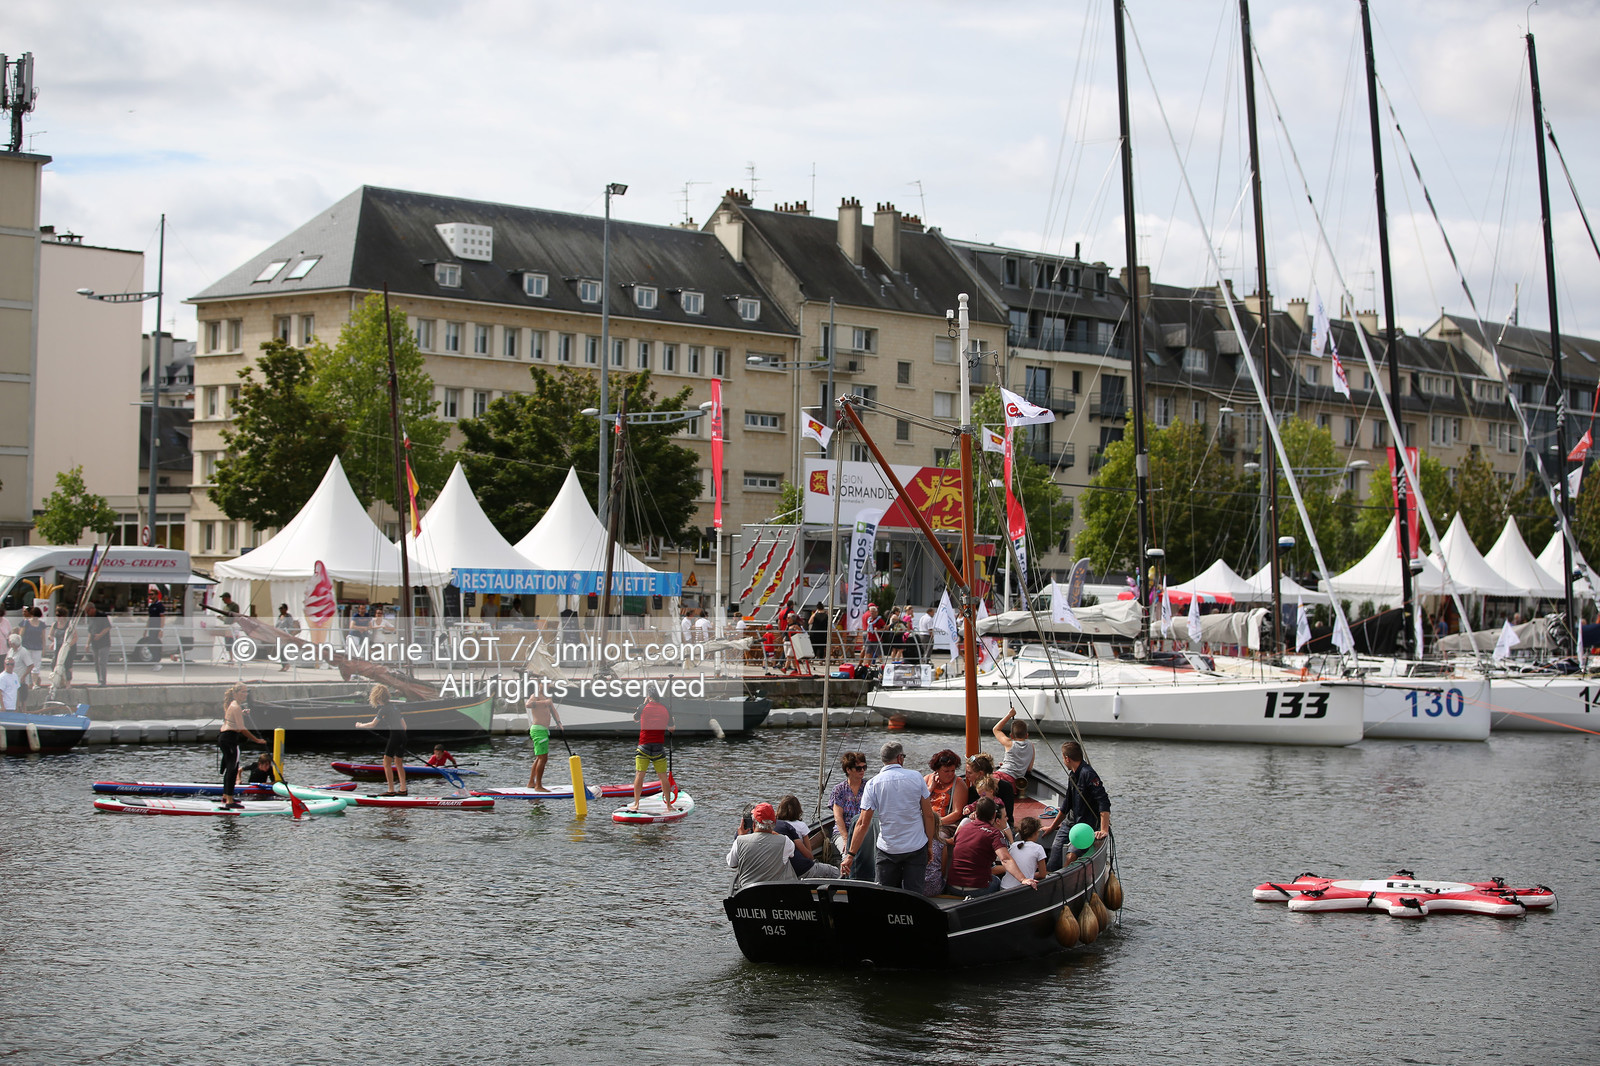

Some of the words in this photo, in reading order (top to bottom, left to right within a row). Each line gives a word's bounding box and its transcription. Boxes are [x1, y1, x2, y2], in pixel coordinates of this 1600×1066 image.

[832, 474, 863, 484] RGION
[68, 558, 177, 568] CHROS-CREPES
[462, 573, 567, 590] RESTAURATION
[850, 537, 867, 619] Calvados
[1264, 691, 1330, 718] 133
[1405, 688, 1464, 718] 130
[735, 908, 767, 919] JULIEN
[772, 909, 818, 922] GERMAINE
[887, 913, 914, 926] CAEN
[761, 925, 787, 936] 1945
